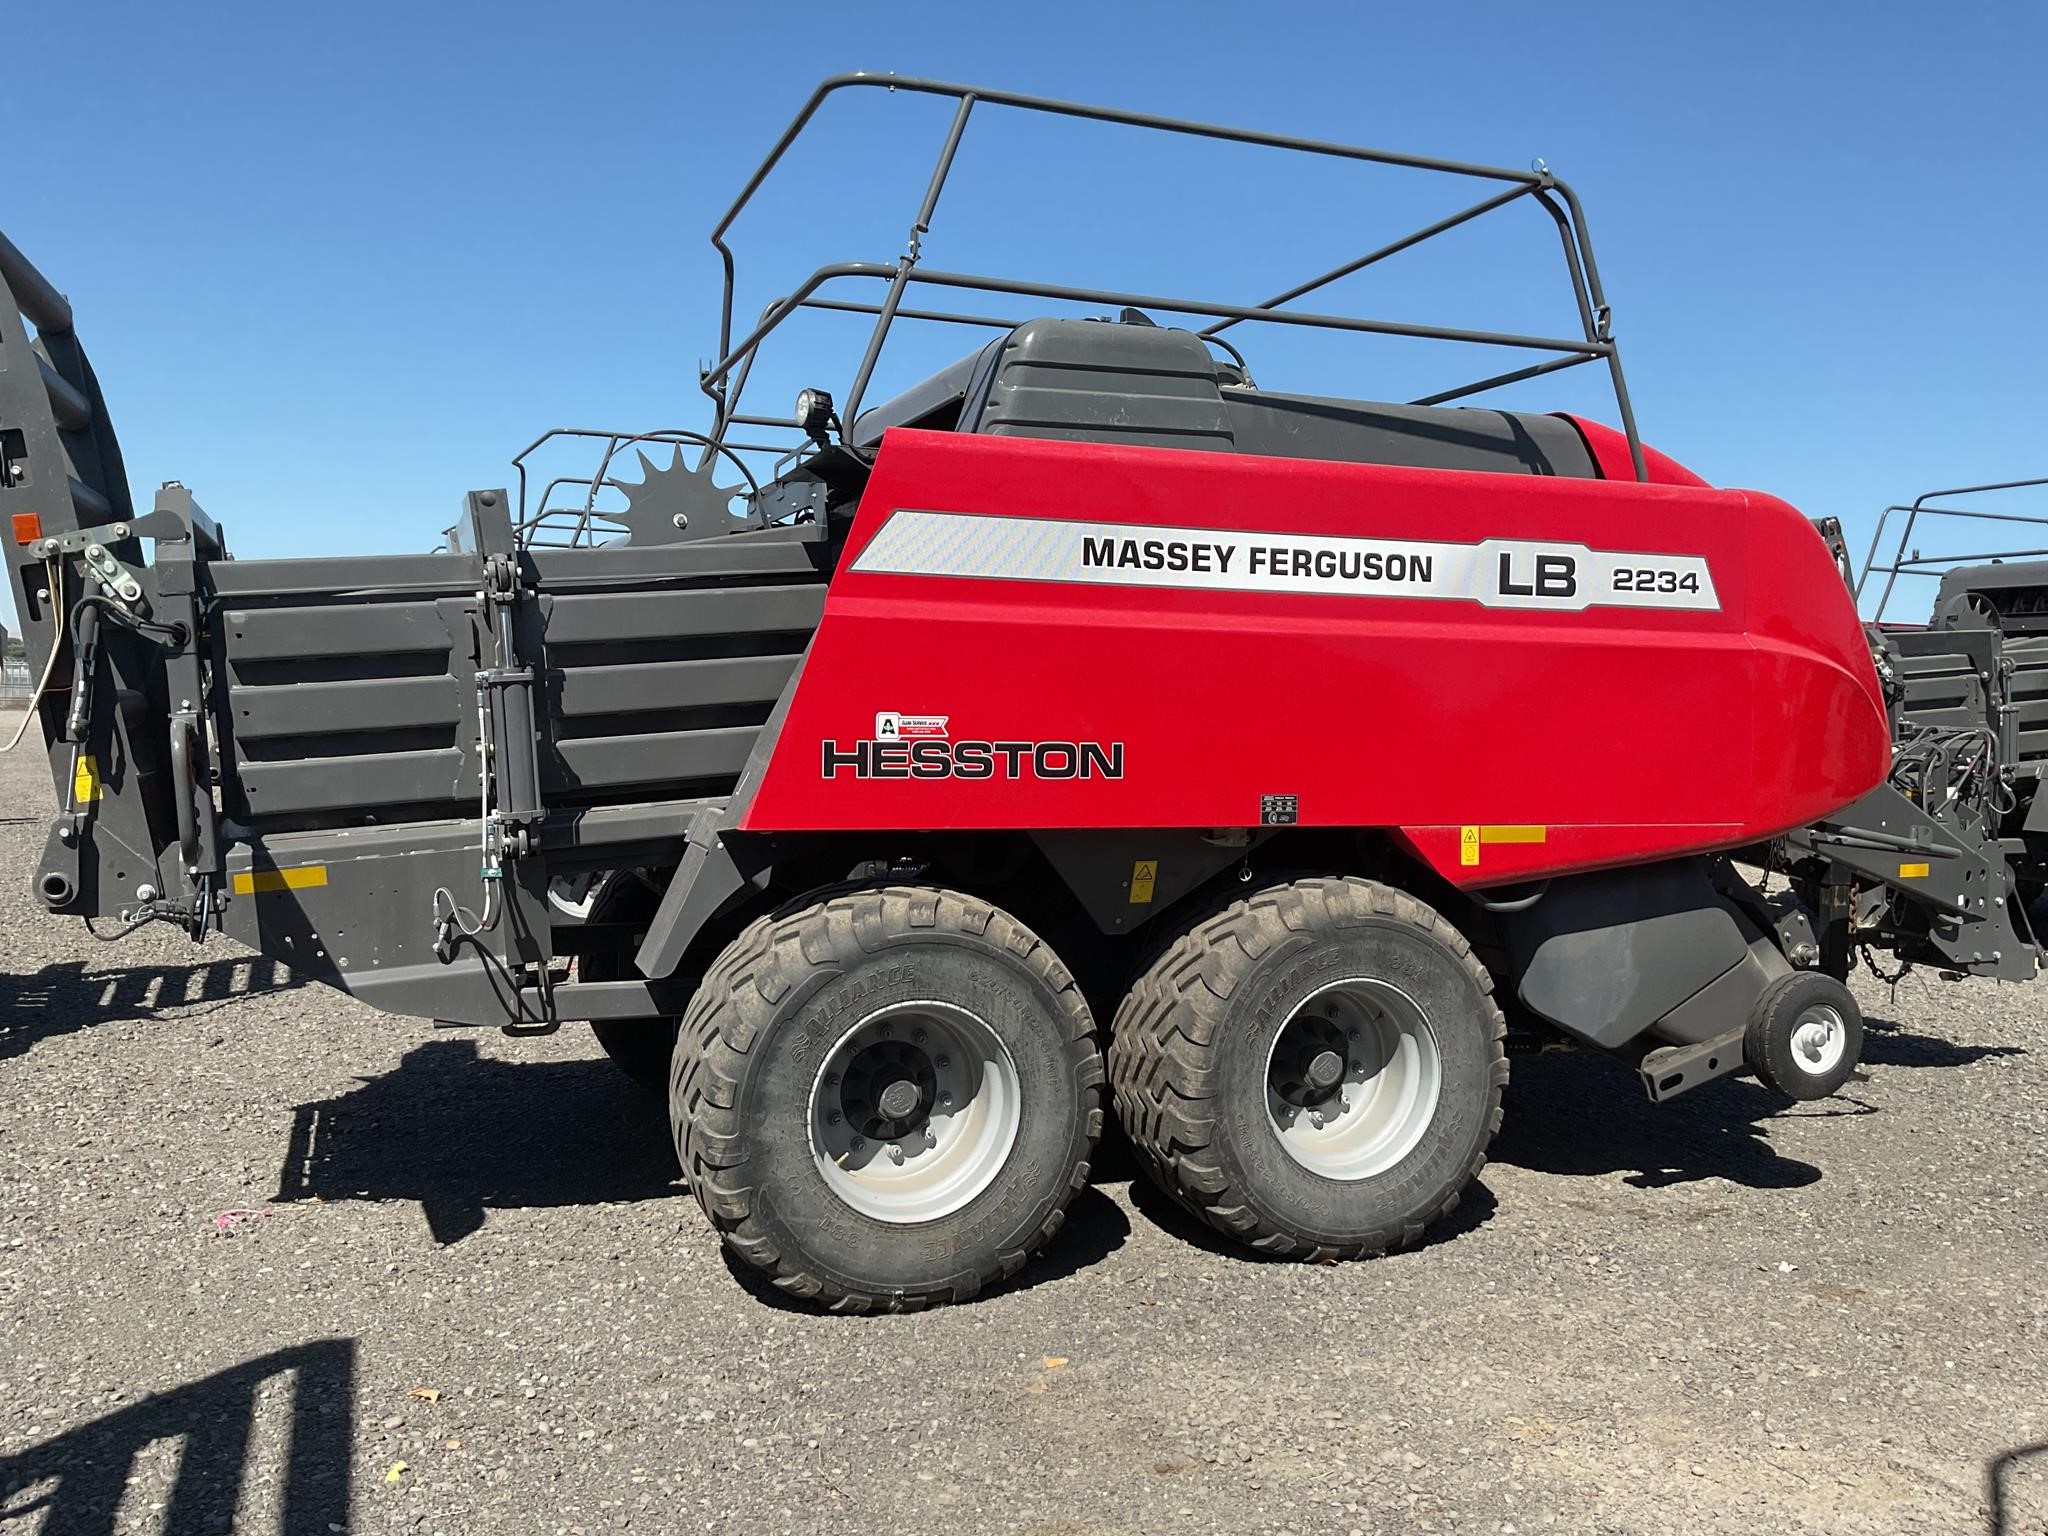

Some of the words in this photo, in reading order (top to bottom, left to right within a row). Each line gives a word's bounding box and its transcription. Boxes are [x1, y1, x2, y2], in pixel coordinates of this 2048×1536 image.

[1083, 536, 1236, 574] MASSEY
[1249, 546, 1432, 582] FERGUSON
[1499, 552, 1576, 597] LB
[1612, 568, 1700, 593] 2234
[822, 739, 1124, 779] HESSTON
[802, 962, 915, 1048] ALLIANCE
[1254, 946, 1341, 1033] ALLIANCE
[922, 1173, 1031, 1264] ALLIANCE
